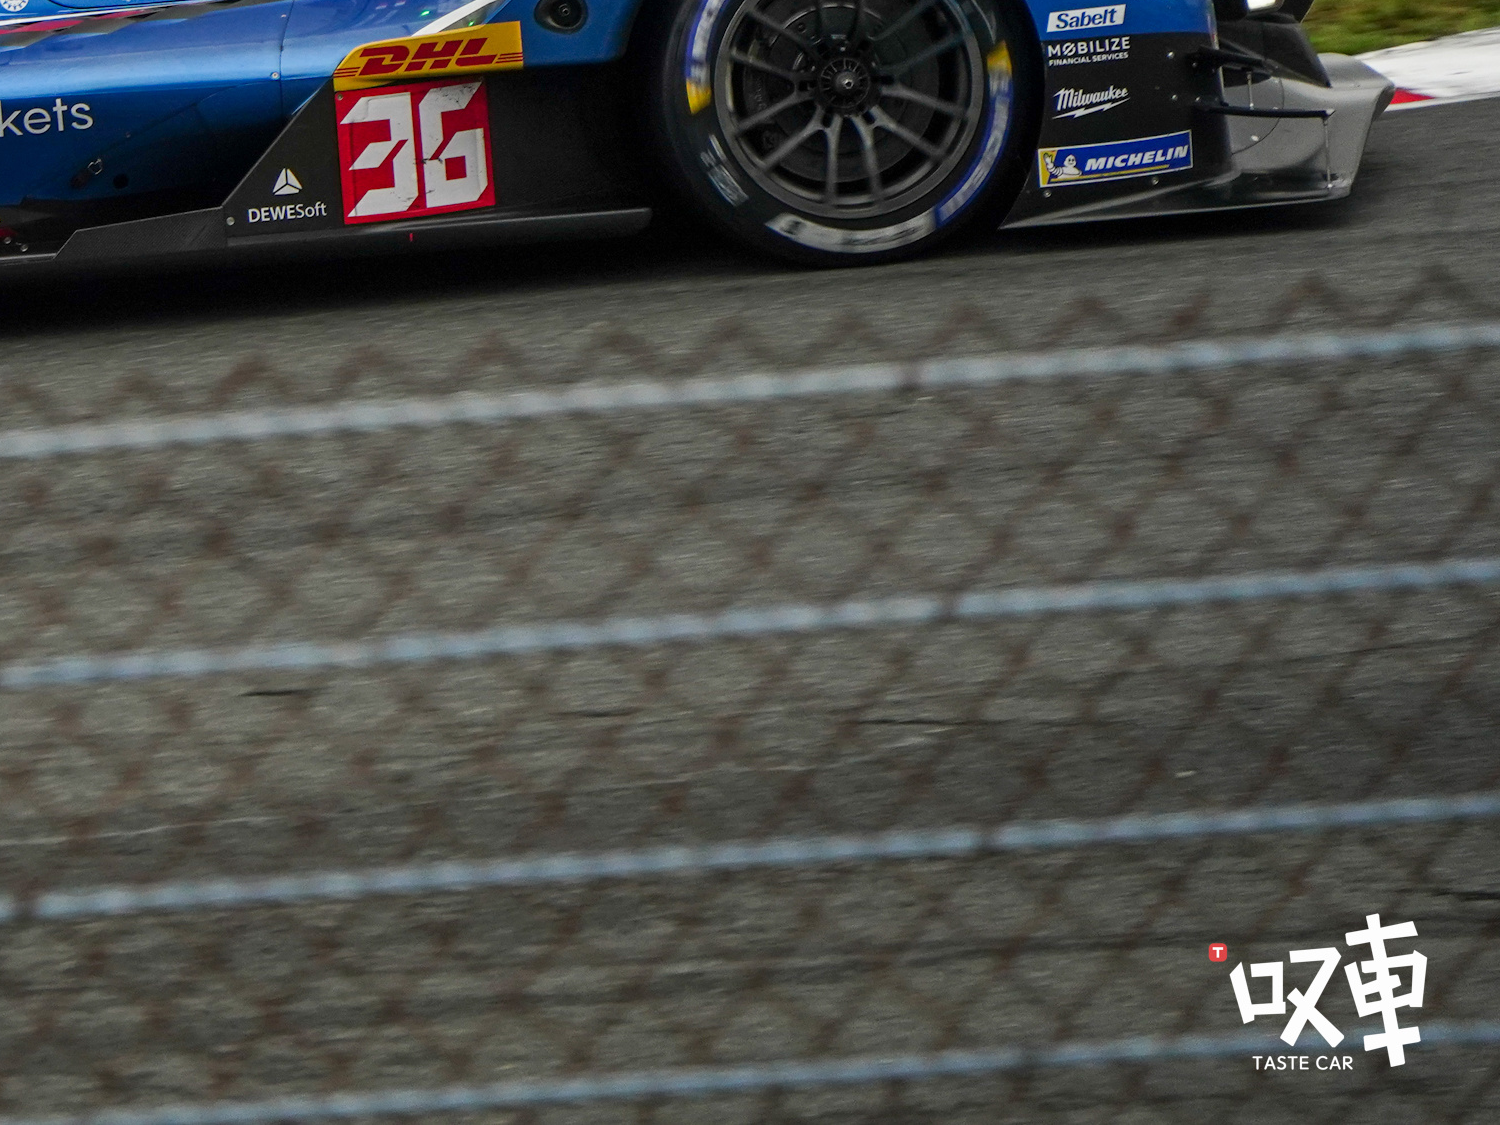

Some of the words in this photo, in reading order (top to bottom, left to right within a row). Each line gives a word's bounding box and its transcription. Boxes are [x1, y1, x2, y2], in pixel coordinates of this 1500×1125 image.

[1055, 7, 1117, 30] Sabelt
[357, 37, 500, 76] DHL
[1048, 57, 1092, 67] FINANCIAL
[1092, 51, 1129, 63] SERVICES
[1053, 85, 1129, 111] Milwaukee
[339, 80, 489, 218] 36
[1085, 145, 1188, 171] MICHELIN
[247, 201, 328, 224] DEWESoft
